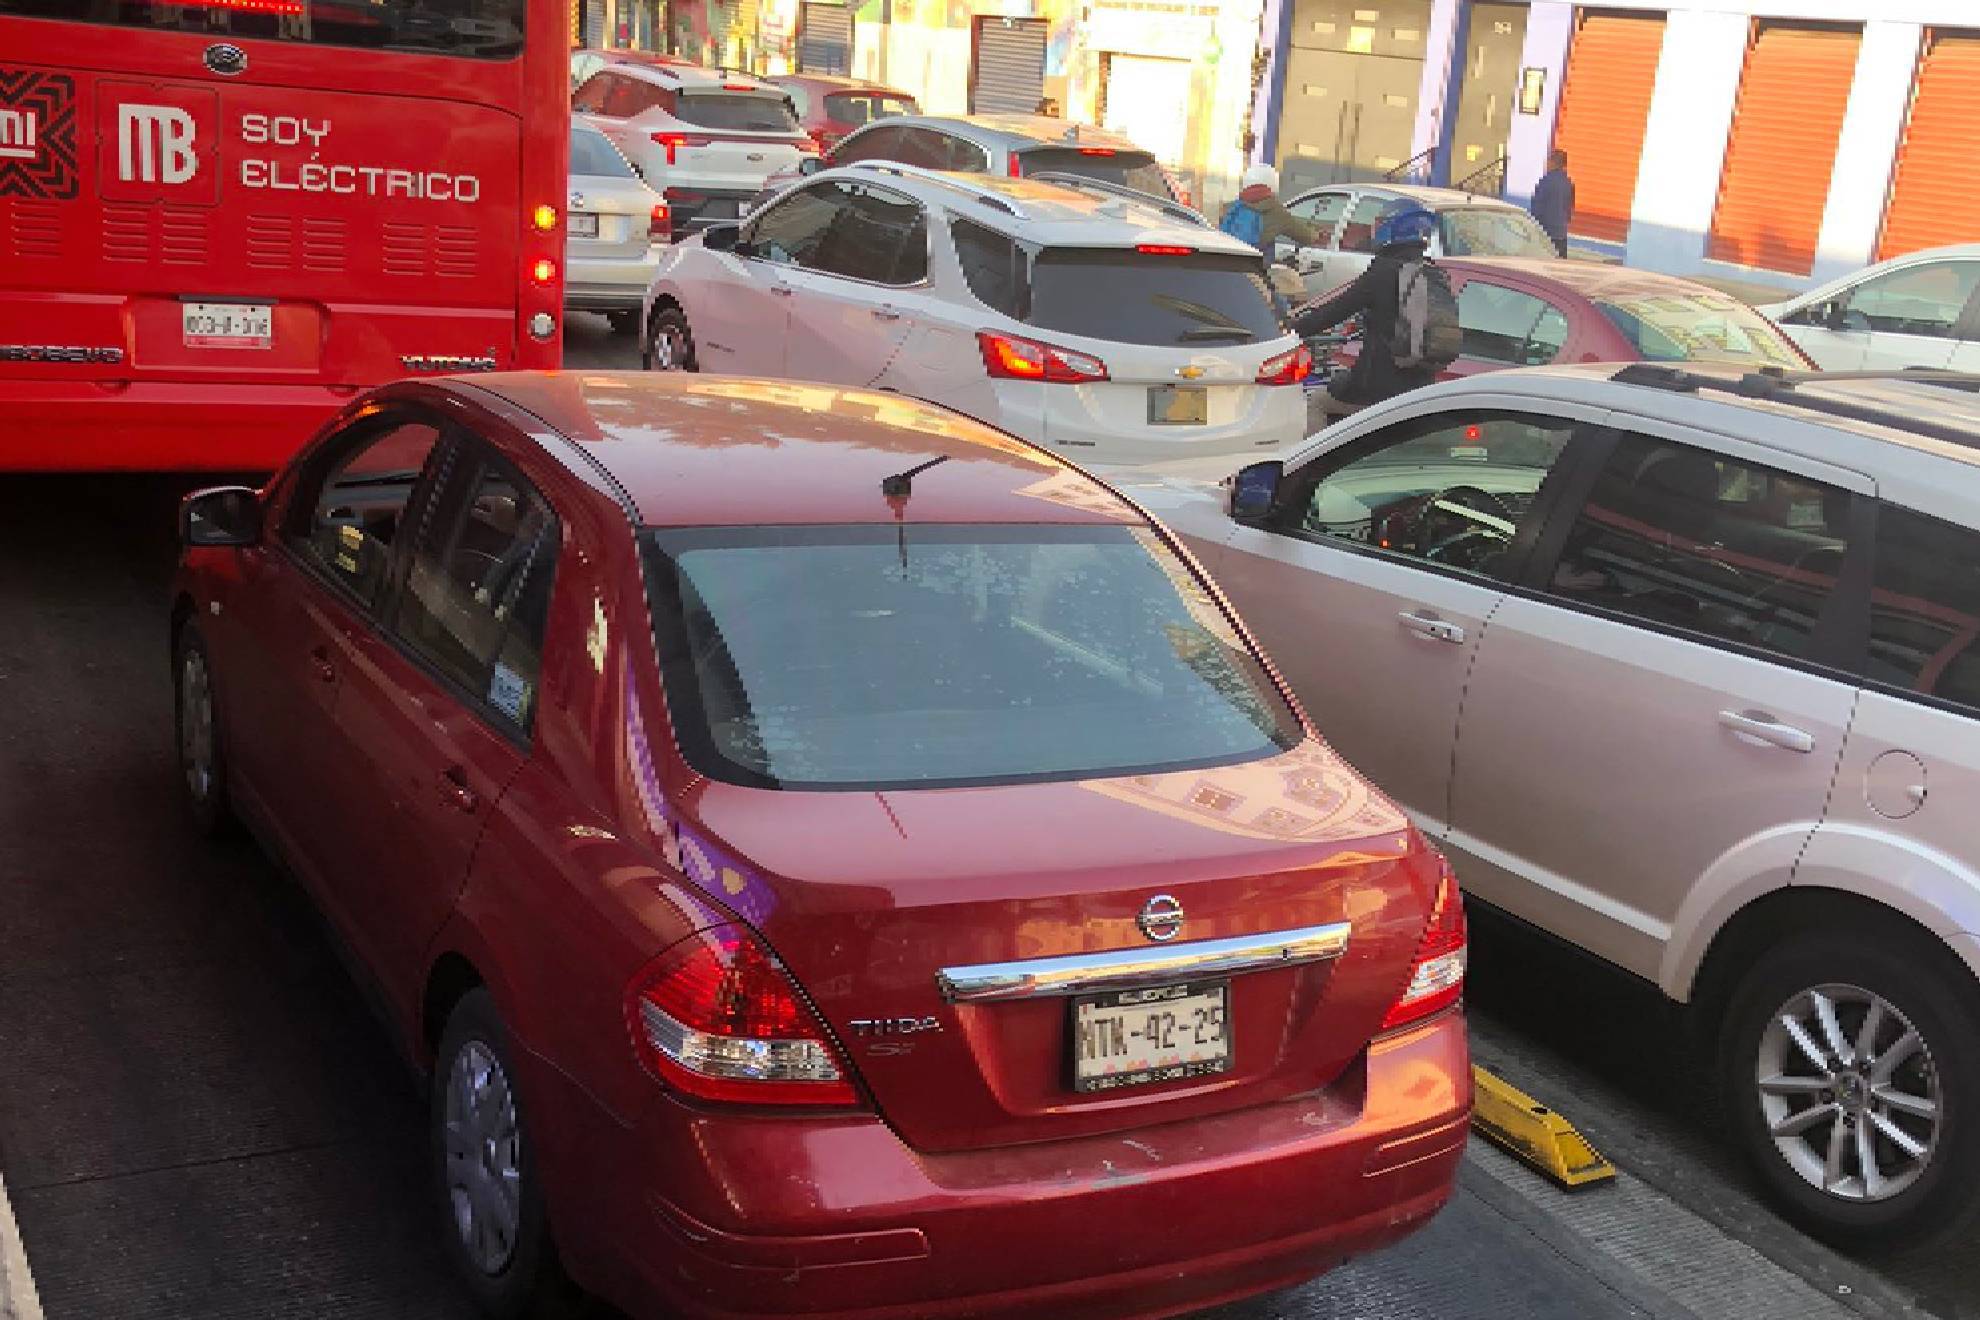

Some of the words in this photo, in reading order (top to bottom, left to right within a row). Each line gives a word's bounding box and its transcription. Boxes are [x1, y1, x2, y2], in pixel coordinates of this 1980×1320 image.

[118, 103, 198, 184] MB
[242, 114, 331, 147] SOY
[241, 152, 480, 203] ELÉCTRICO
